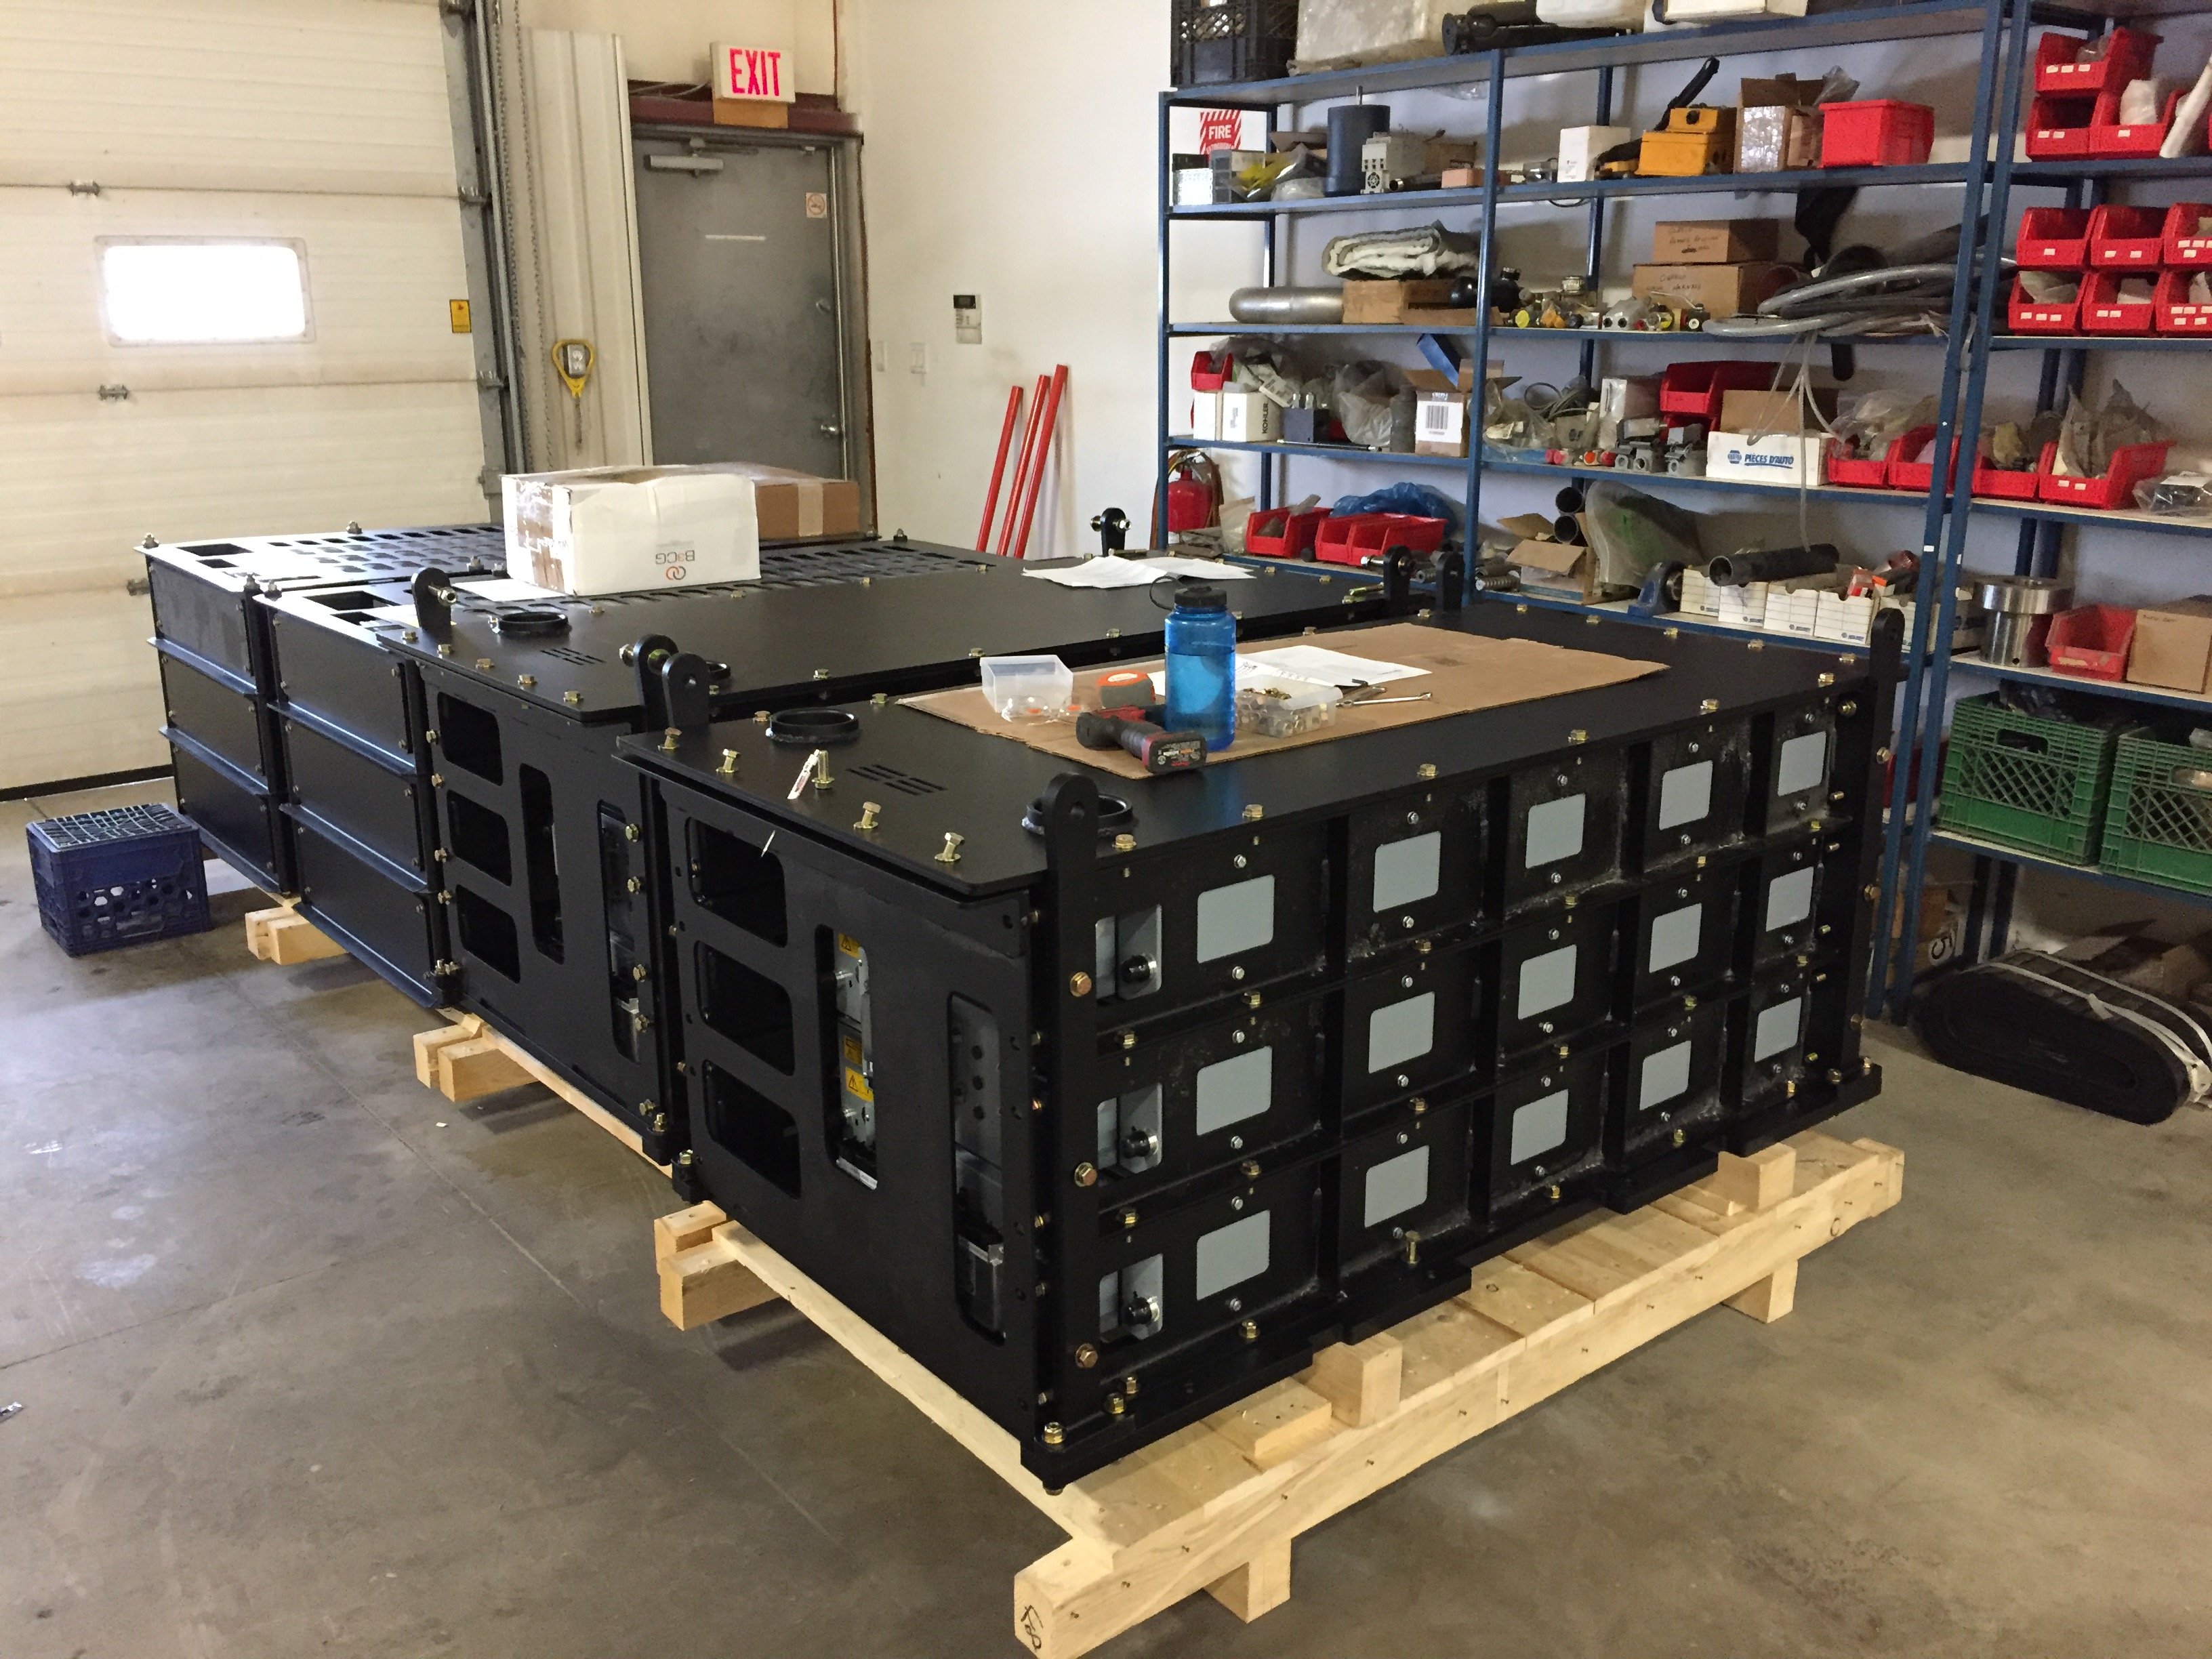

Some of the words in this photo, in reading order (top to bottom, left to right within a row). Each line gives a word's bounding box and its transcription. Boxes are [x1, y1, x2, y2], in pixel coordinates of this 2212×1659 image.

[729, 48, 781, 96] EXIT
[1208, 125, 1232, 140] FIRE
[655, 550, 695, 565] B3CG
